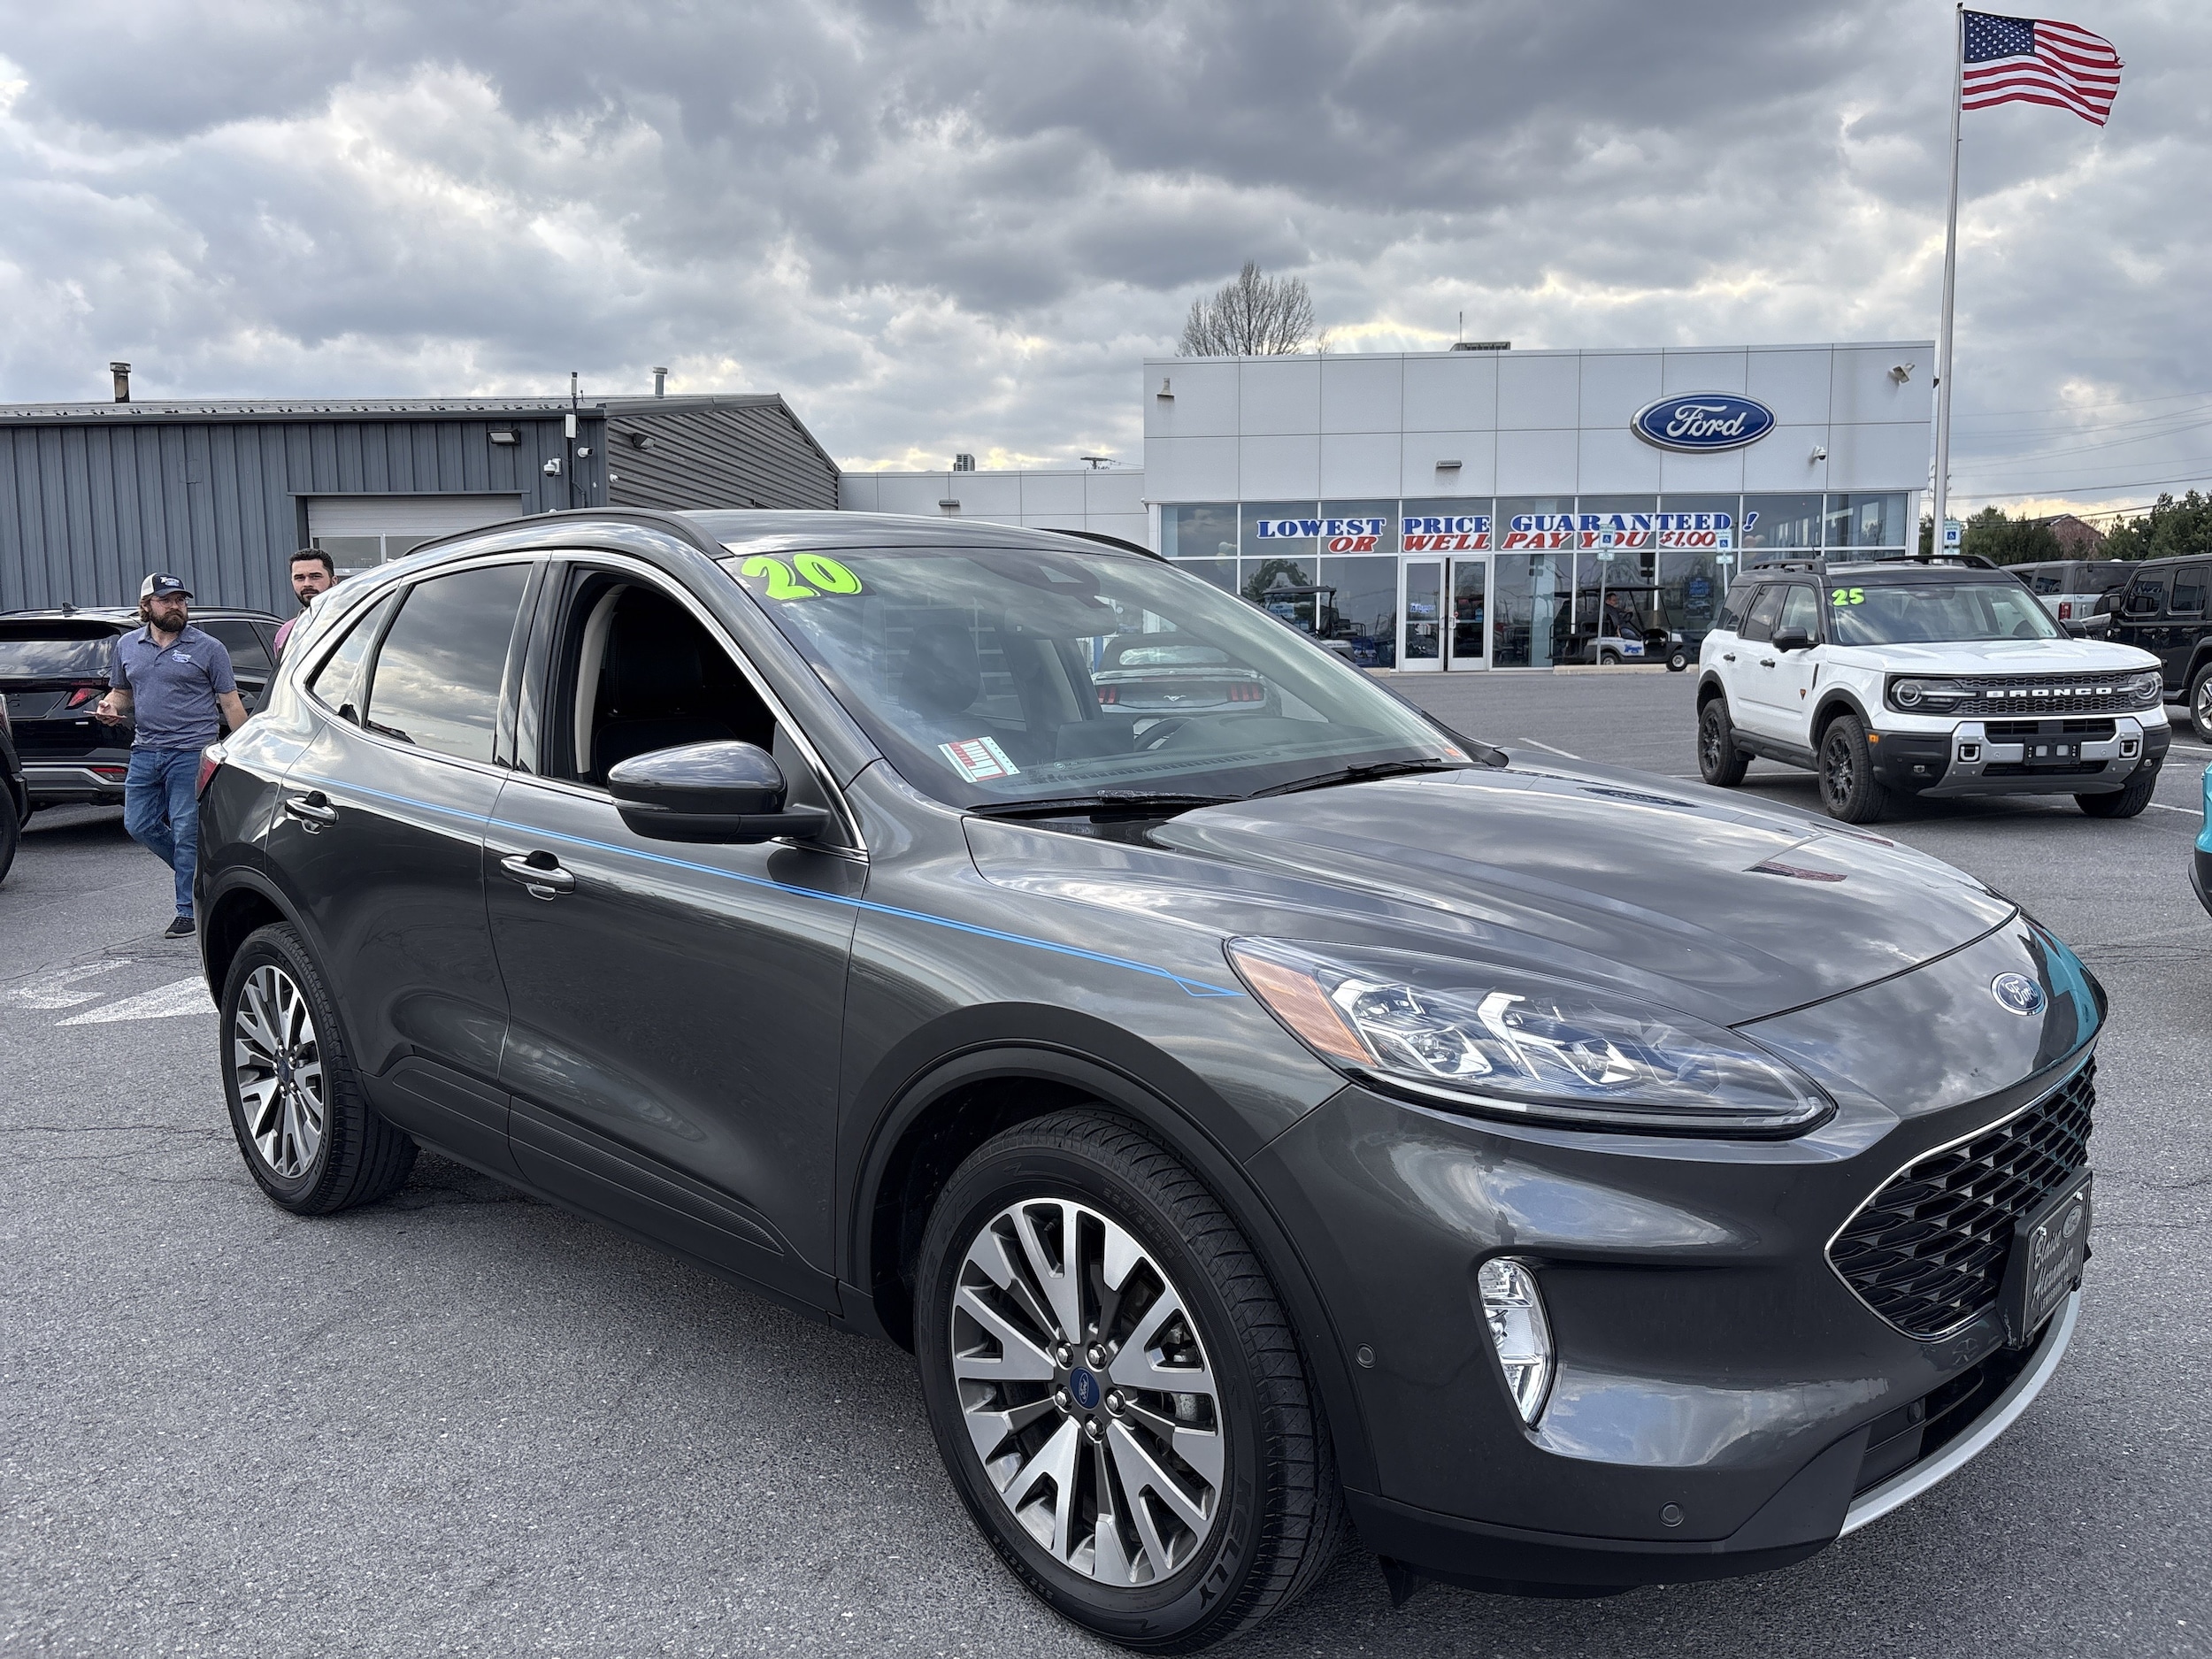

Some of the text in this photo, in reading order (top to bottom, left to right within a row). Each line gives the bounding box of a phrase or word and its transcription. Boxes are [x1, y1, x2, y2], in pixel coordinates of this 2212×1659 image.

[1666, 404, 1747, 437] Ford
[1257, 518, 1386, 538] LOWEST
[1402, 516, 1491, 534] PRICE
[1328, 536, 1379, 553] OR
[1502, 532, 1573, 549] PAY
[741, 552, 863, 601] 20
[1831, 588, 1865, 606] 25
[1985, 687, 2112, 698] BRONCO
[2004, 979, 2039, 1006] Ford
